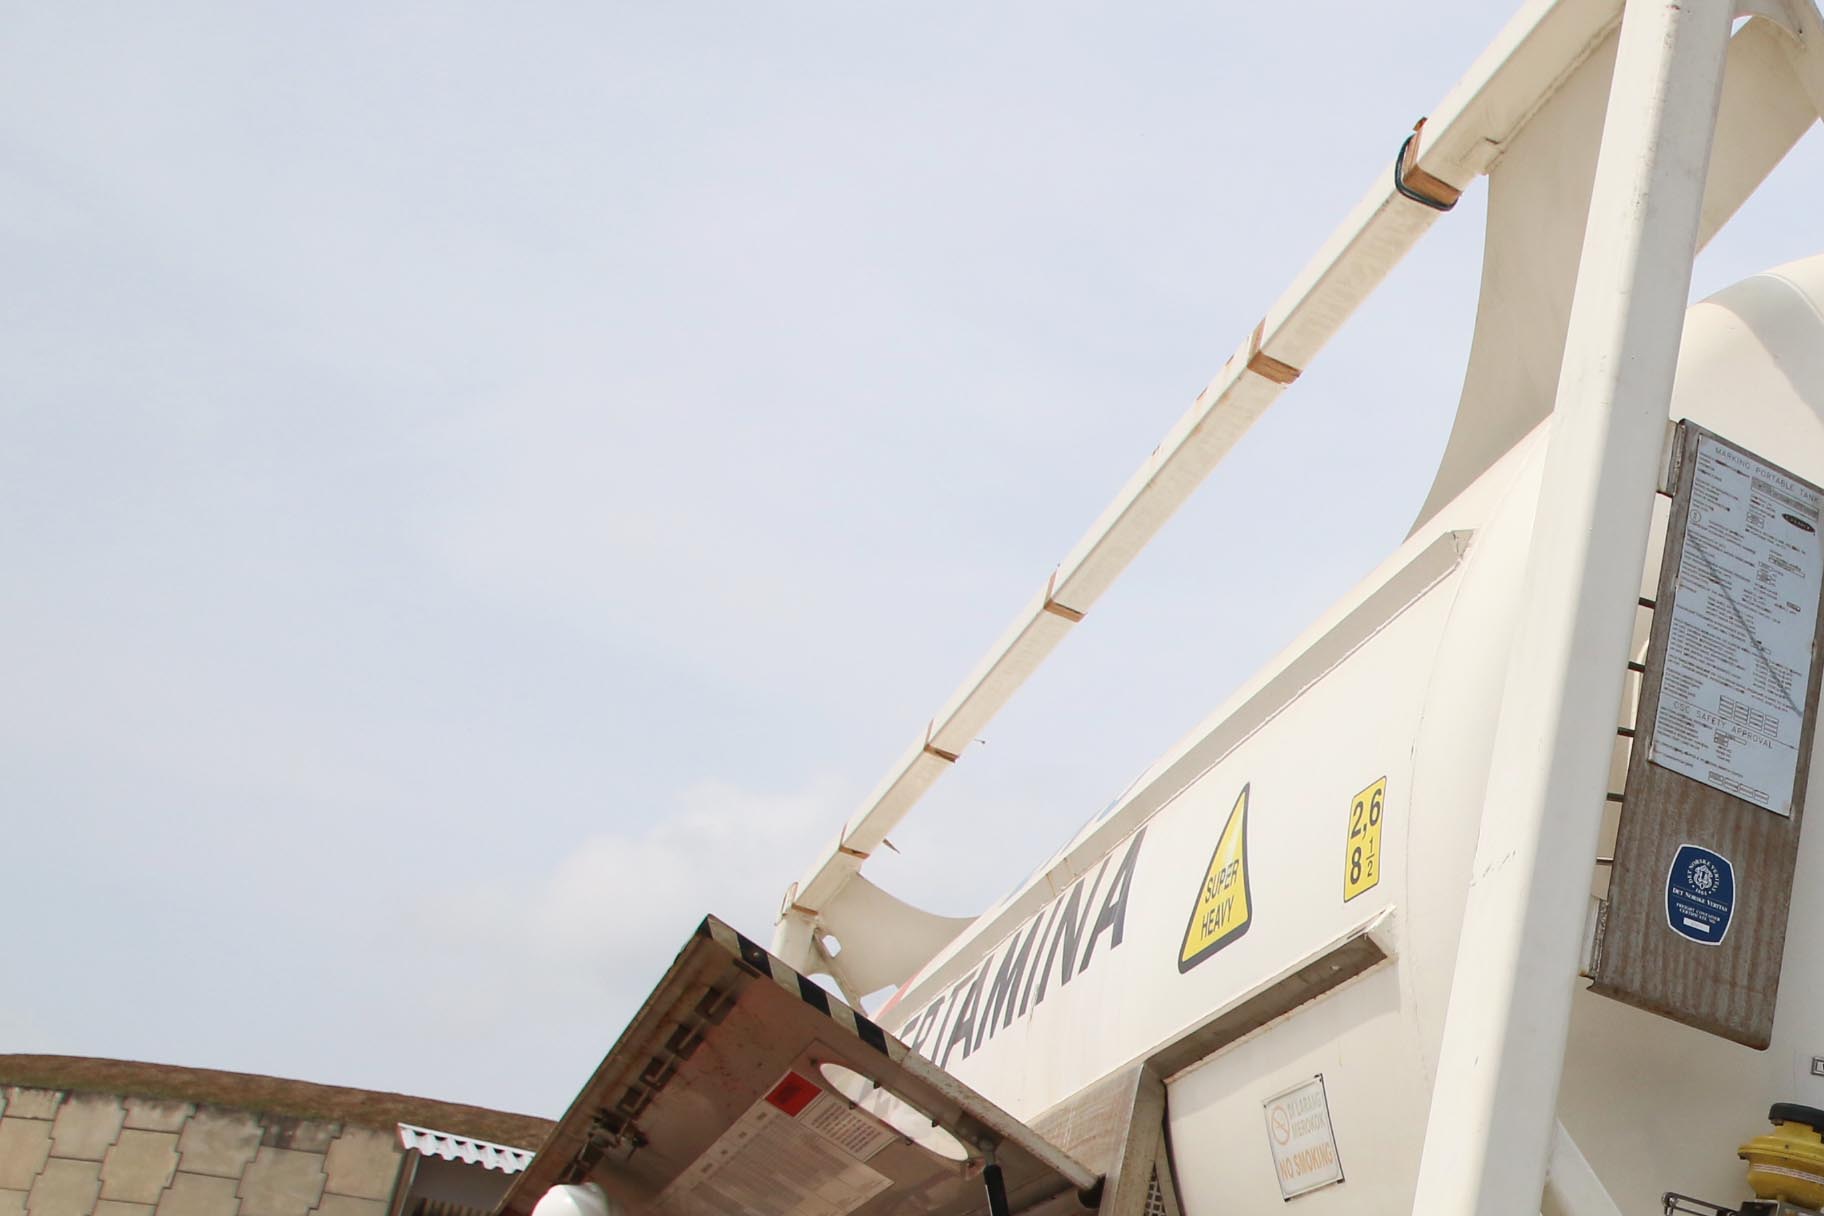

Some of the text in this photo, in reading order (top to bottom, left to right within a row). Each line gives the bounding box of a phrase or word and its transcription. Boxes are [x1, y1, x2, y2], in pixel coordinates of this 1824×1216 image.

[1205, 859, 1239, 904] SUPER
[1201, 896, 1234, 940] HEAVY
[1280, 1142, 1334, 1180] NO SMOKING
